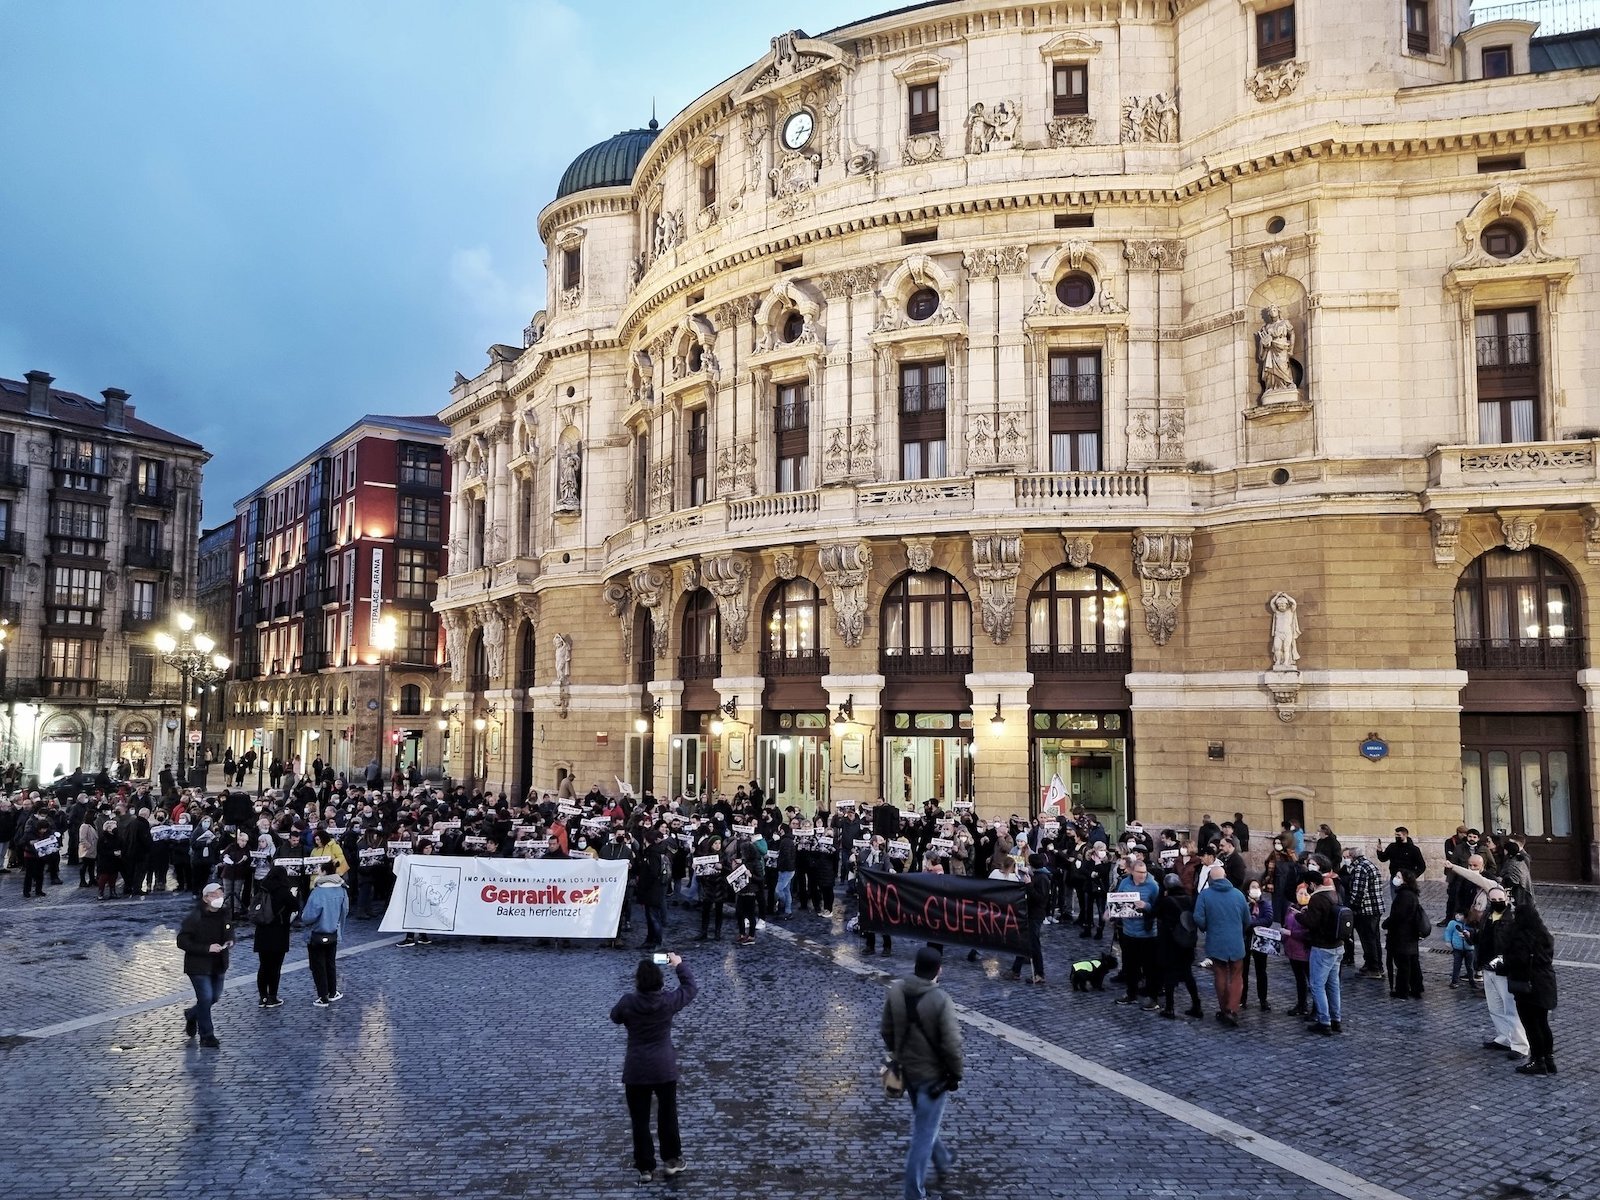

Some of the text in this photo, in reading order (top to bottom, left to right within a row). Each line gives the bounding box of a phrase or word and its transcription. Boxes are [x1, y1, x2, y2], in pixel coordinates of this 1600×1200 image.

[481, 884, 567, 905] Gerrarik
[496, 905, 581, 917] Bakea herrientzat
[866, 882, 900, 924] NO
[924, 895, 1020, 936] GUERRA
